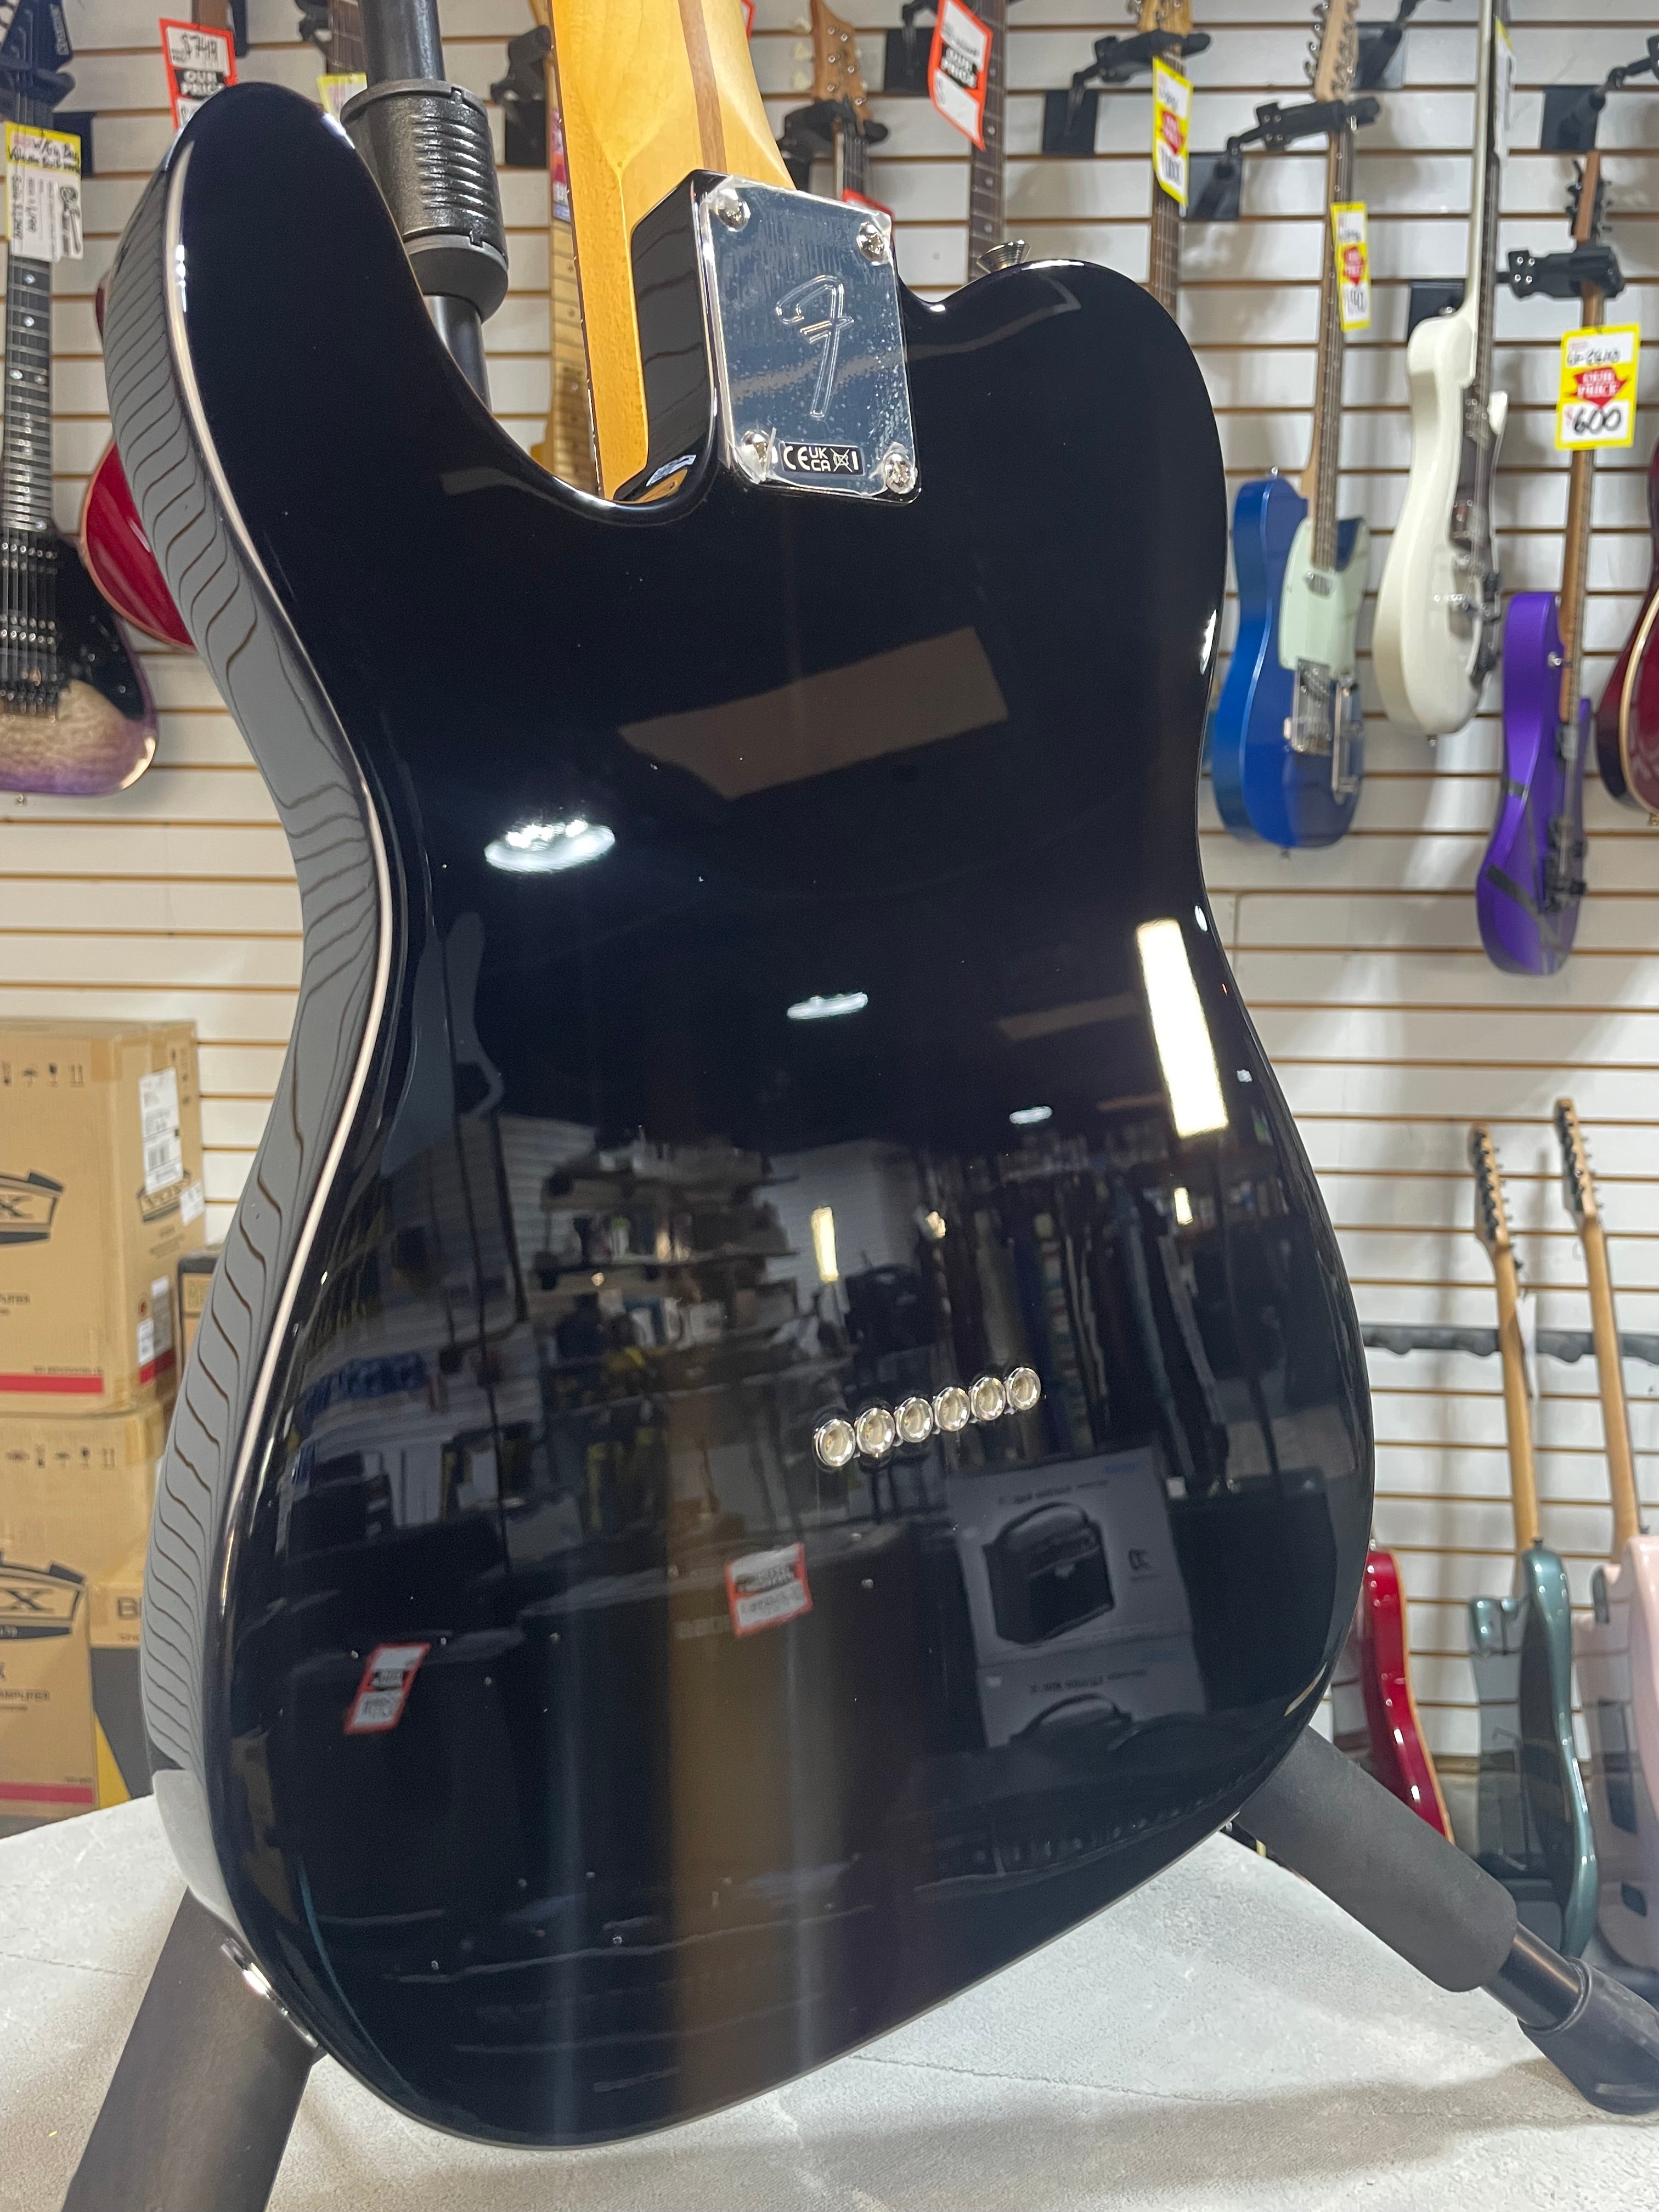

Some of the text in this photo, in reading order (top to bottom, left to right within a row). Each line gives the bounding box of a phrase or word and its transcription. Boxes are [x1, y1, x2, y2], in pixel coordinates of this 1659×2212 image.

[183, 70, 217, 83] OUR
[1582, 370, 1613, 383] OUR
[1577, 383, 1618, 398] PRICE
[809, 447, 828, 459] UK
[810, 459, 831, 472] CA
